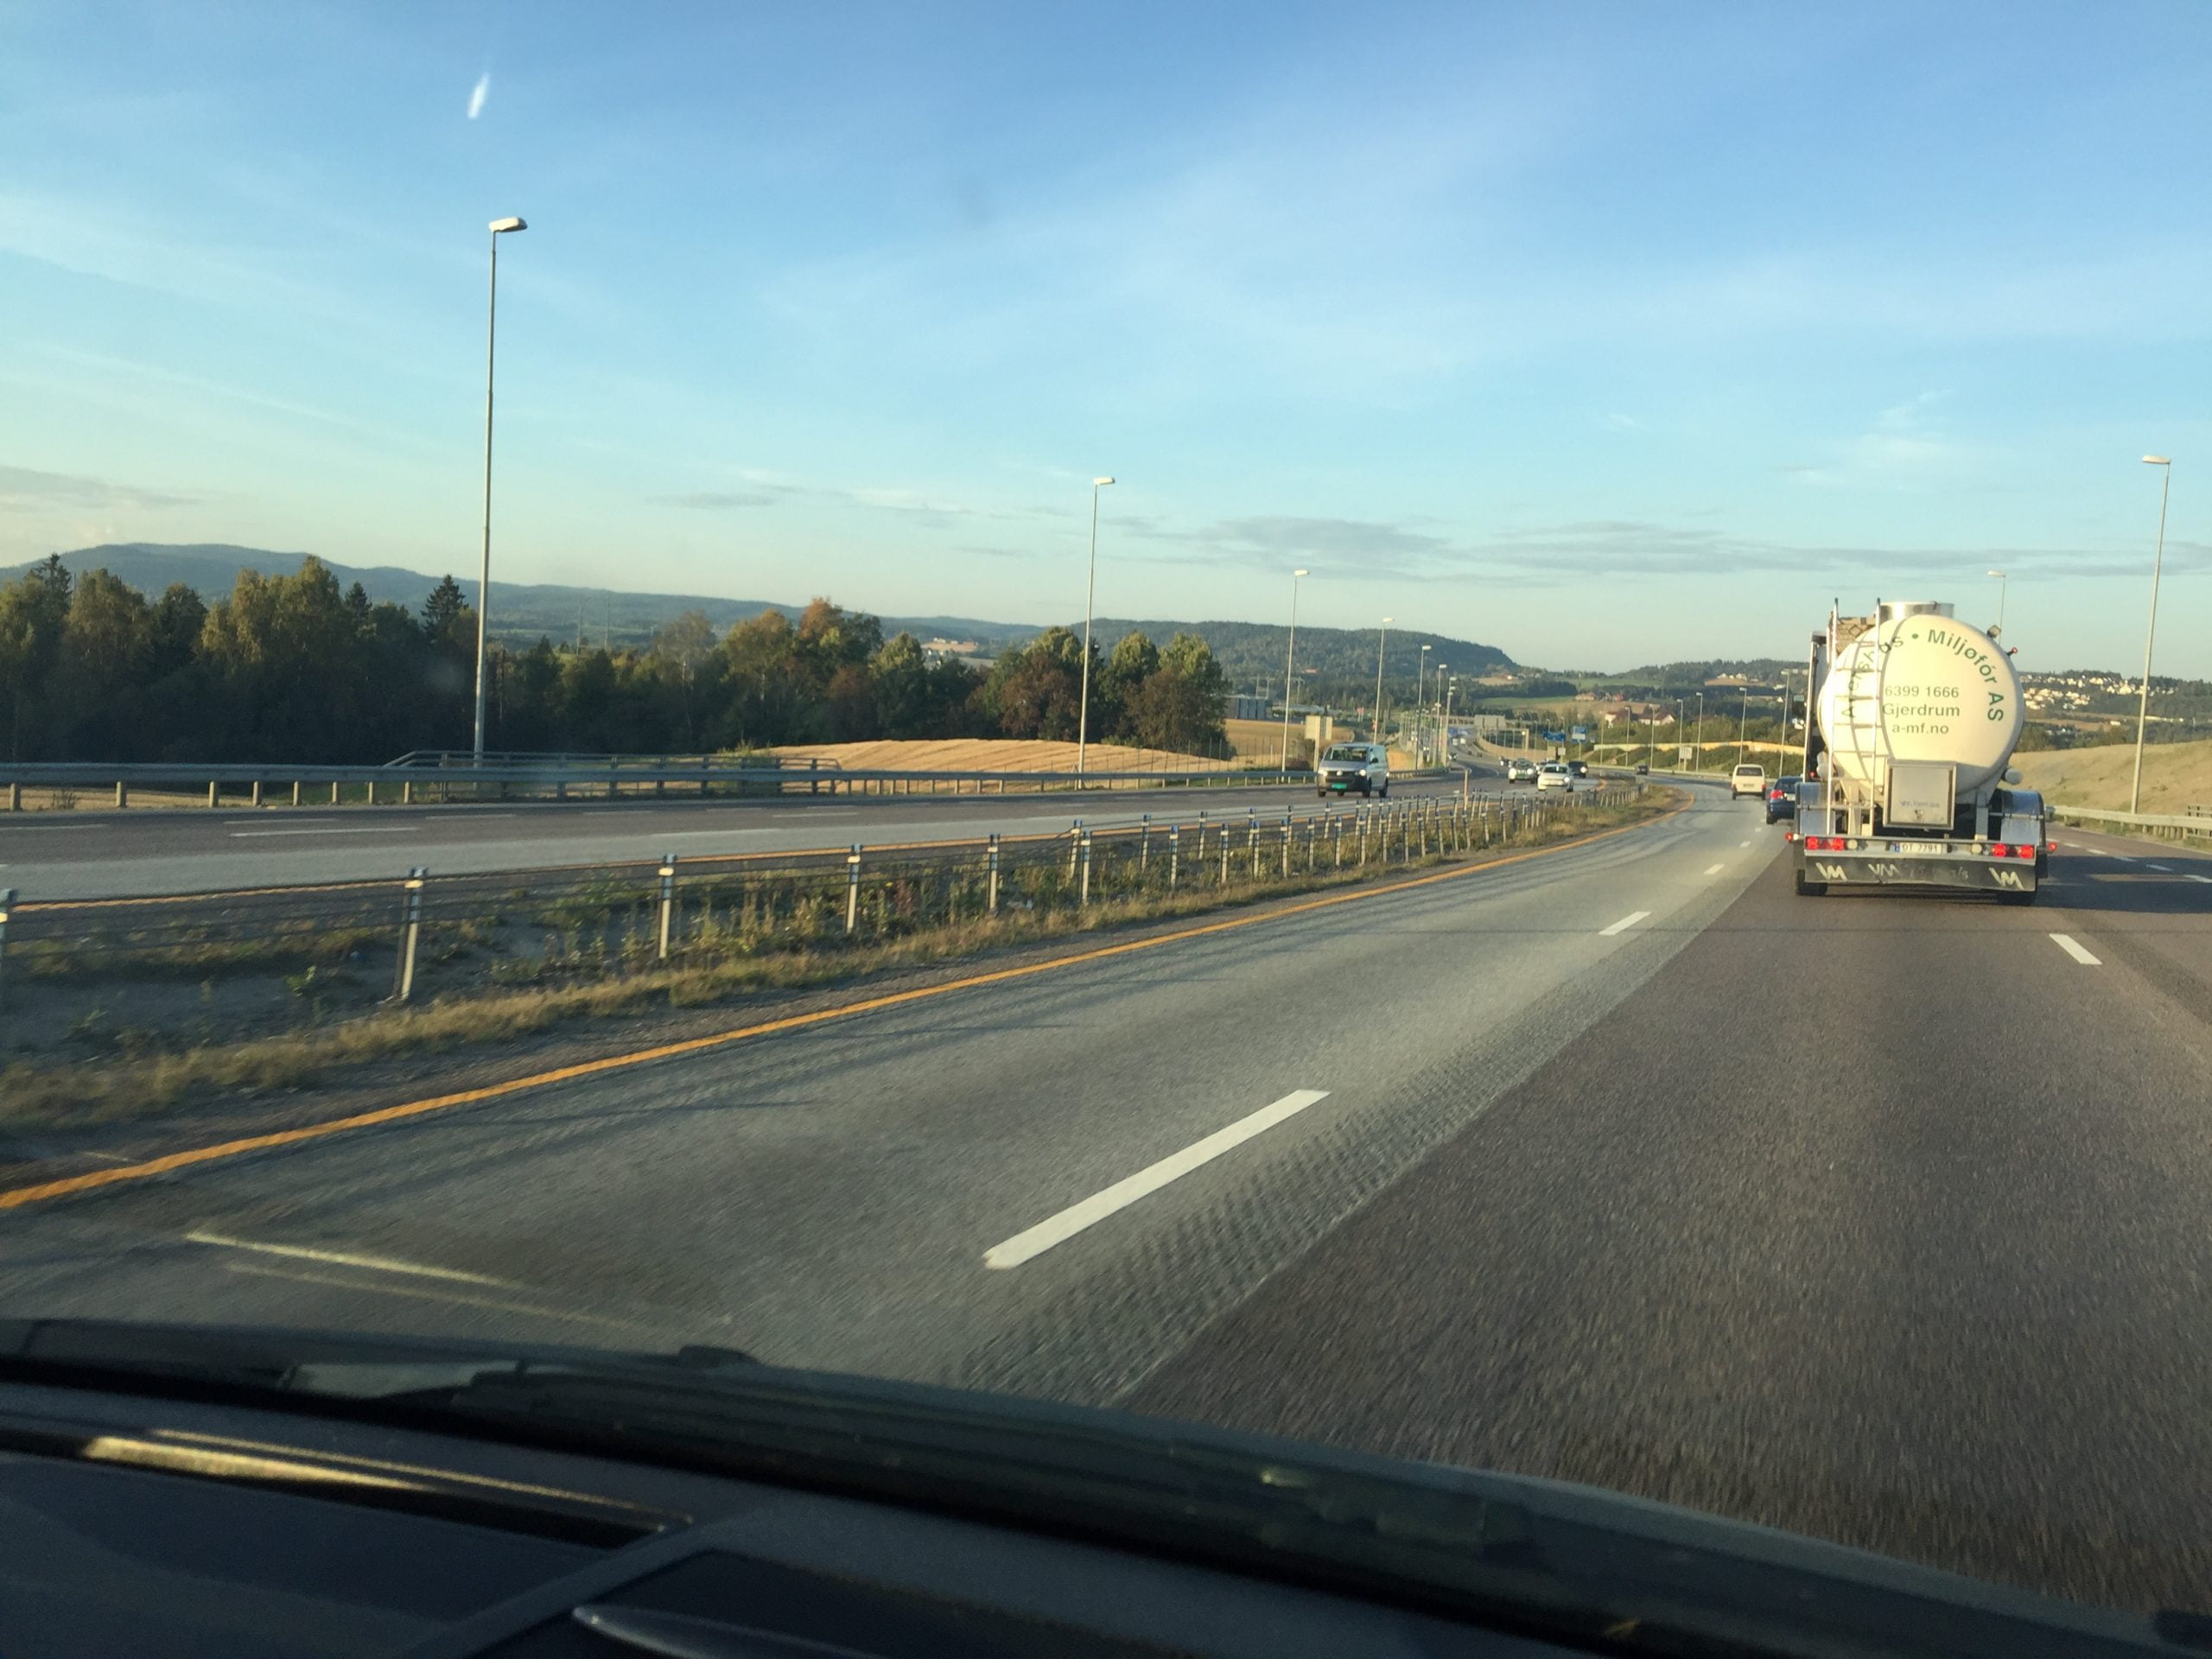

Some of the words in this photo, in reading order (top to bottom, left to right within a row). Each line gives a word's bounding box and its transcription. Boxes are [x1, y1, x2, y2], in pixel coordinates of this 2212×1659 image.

[1885, 685, 1920, 697] 6399
[1926, 686, 1960, 698] 1666
[1883, 702, 1960, 718] Gjerdrum
[1987, 691, 2004, 721] AS
[1892, 722, 1949, 734] a-mf.no
